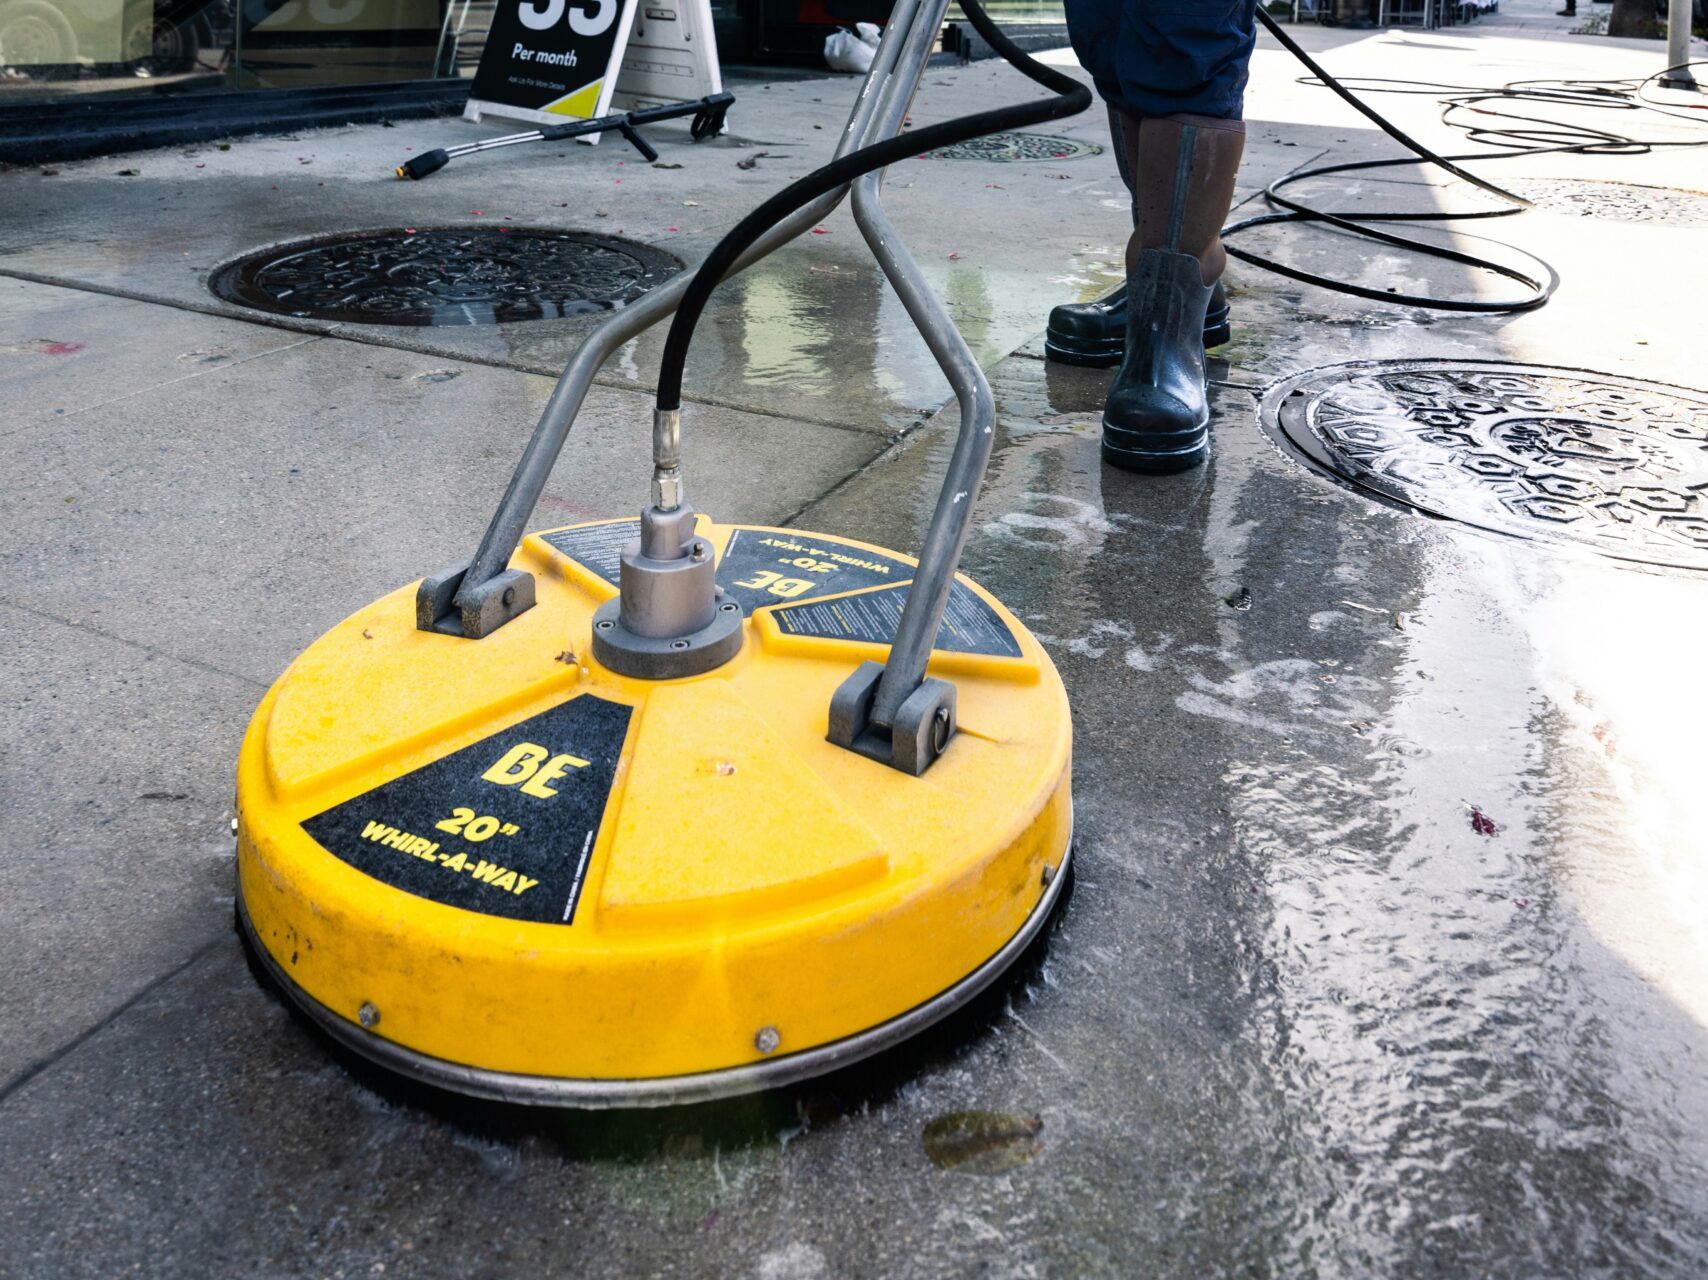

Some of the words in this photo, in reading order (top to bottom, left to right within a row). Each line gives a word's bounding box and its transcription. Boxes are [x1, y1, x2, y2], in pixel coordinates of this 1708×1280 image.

[511, 42, 535, 61] Per
[536, 50, 577, 67] month
[758, 537, 890, 574] WHIRL-A-WAY
[733, 570, 817, 597] BE
[480, 742, 591, 799] BE
[361, 820, 539, 895] WHIRL-A-WAY
